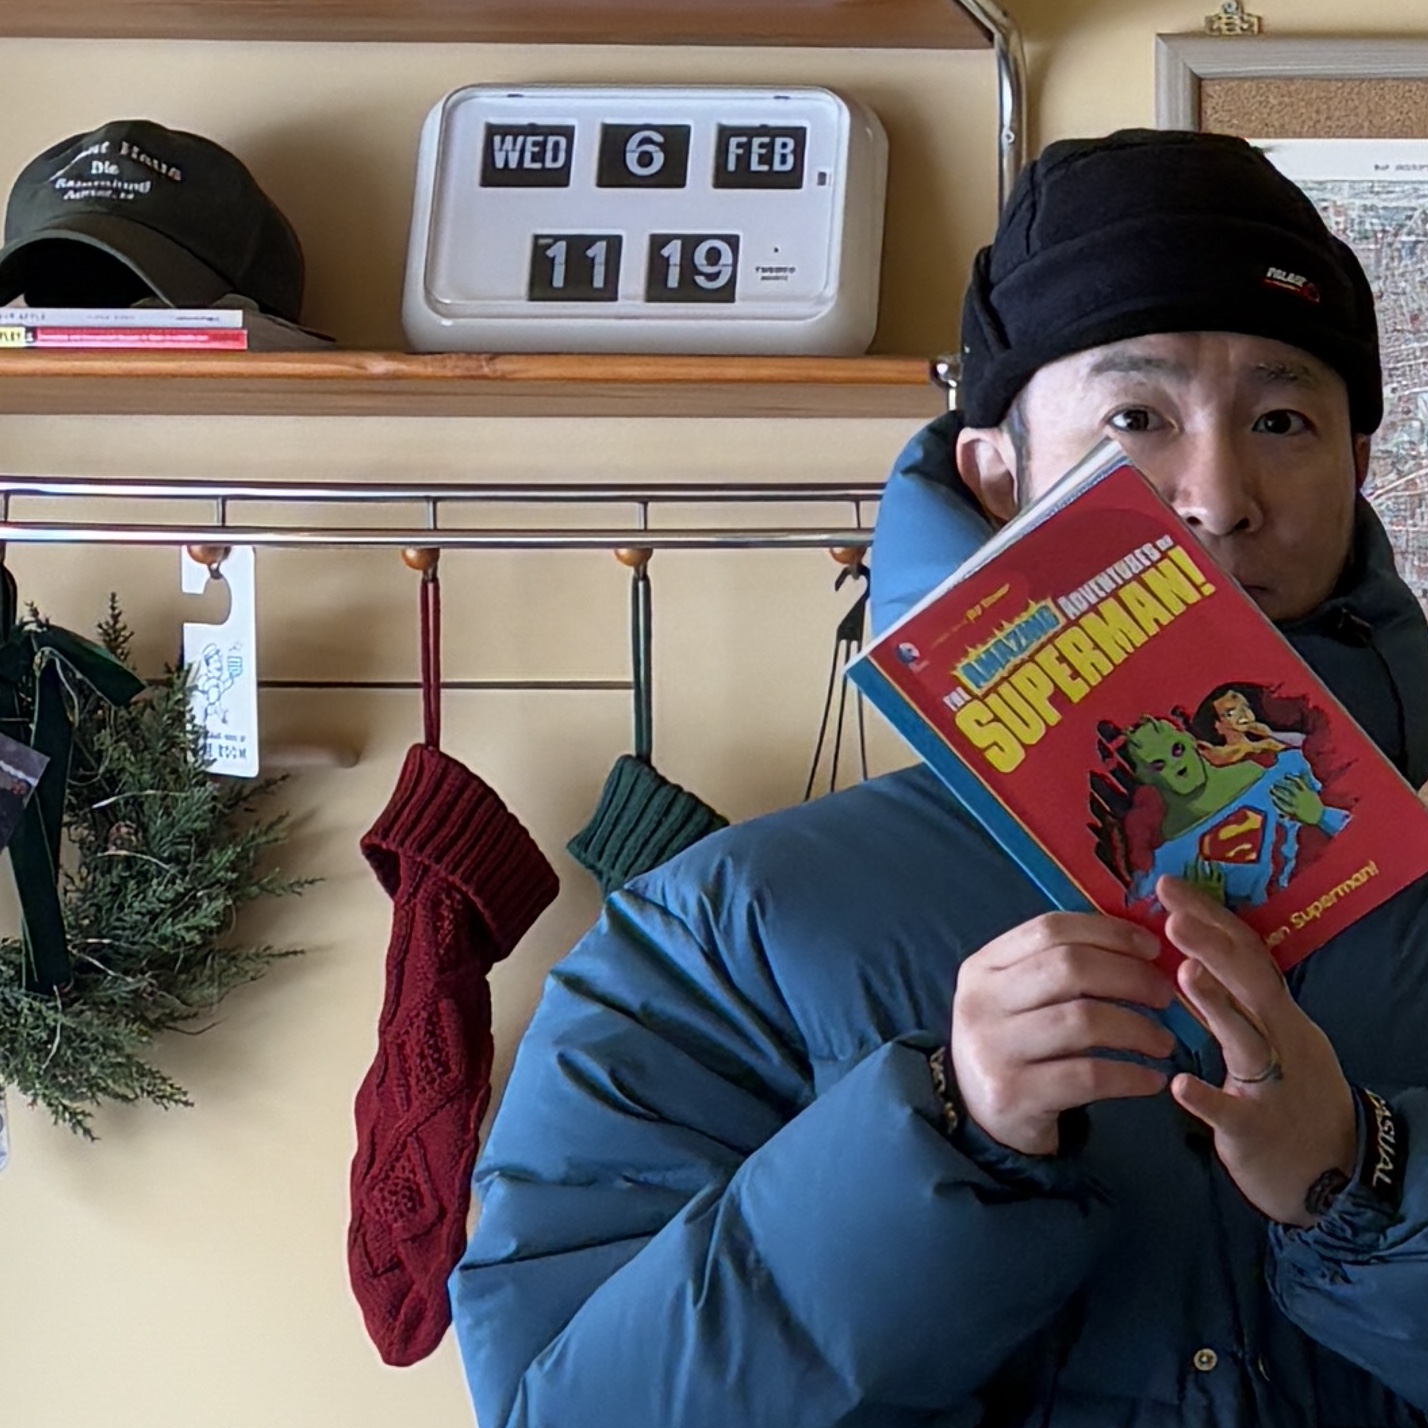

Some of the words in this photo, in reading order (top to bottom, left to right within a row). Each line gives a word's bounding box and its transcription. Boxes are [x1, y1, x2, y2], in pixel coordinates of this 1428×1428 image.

[493, 135, 567, 169] WED
[625, 130, 665, 176] 6
[727, 136, 795, 173] FEB
[545, 240, 607, 289] 11
[660, 239, 733, 290] 19
[955, 546, 1216, 773] SUPERMAN!
